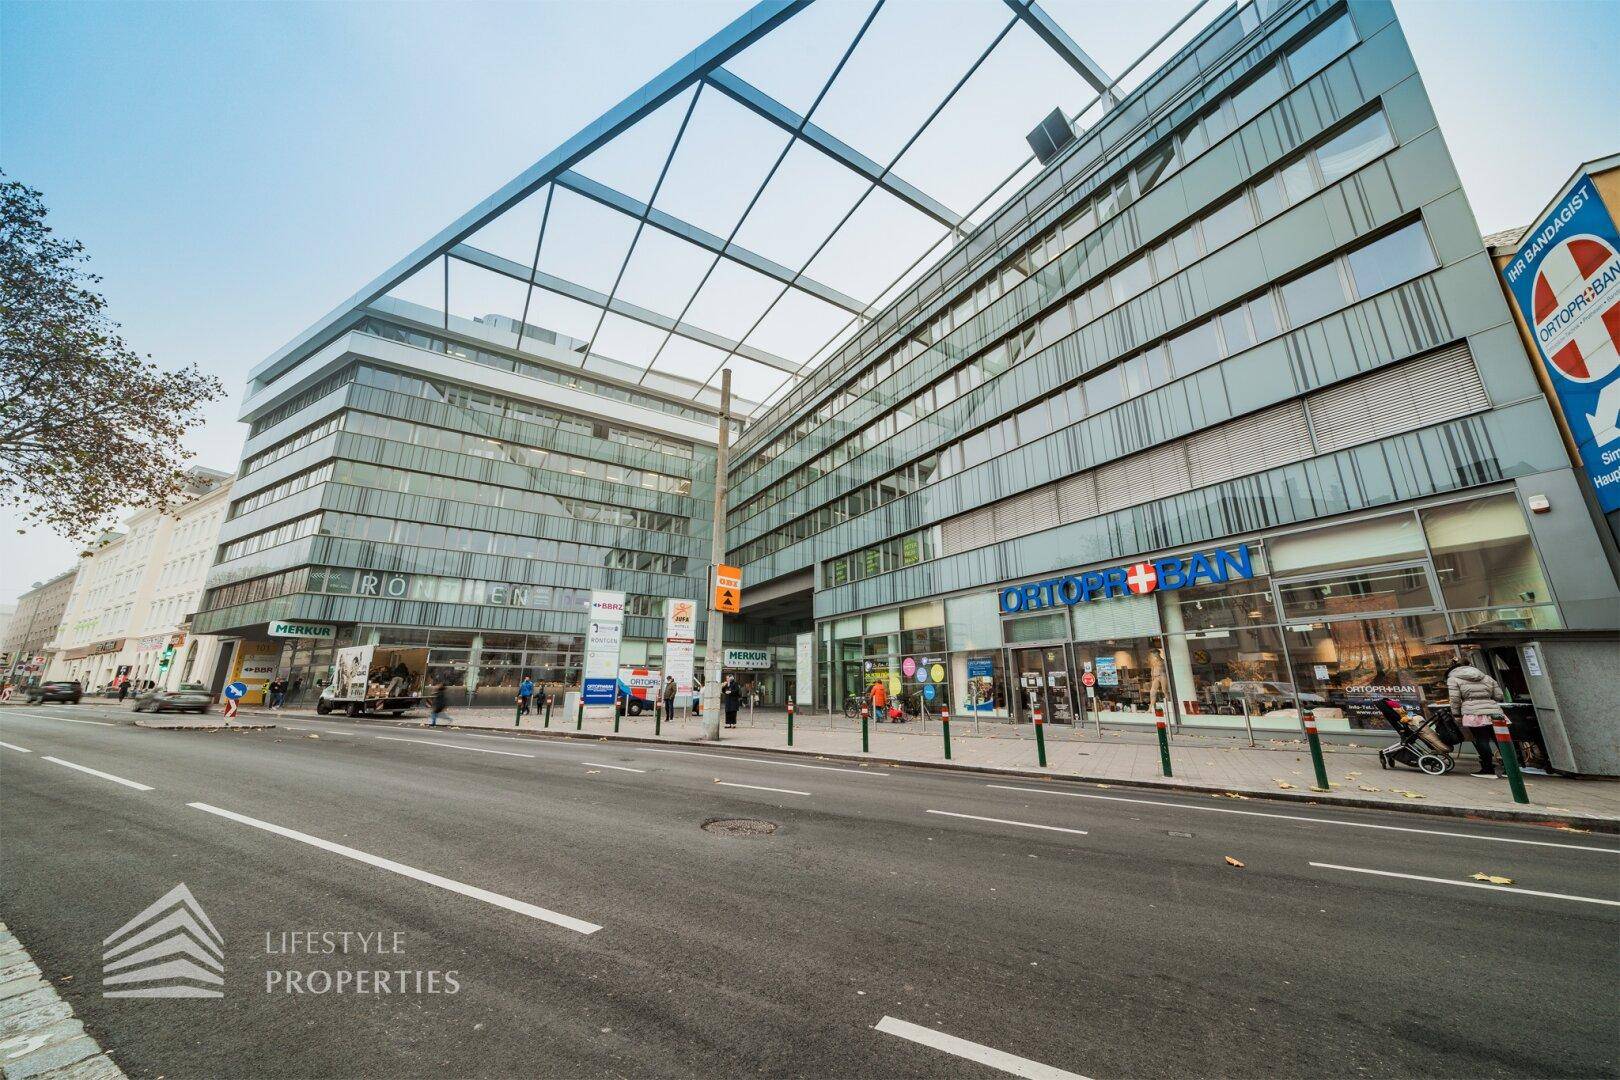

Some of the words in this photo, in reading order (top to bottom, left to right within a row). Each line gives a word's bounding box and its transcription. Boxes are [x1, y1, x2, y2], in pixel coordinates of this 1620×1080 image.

[1508, 259, 1526, 282] IHR
[1524, 185, 1590, 263] BANDAGIST
[602, 602, 623, 611] BBRZ
[275, 624, 331, 636] MERKUR
[729, 651, 767, 661] MERKUR
